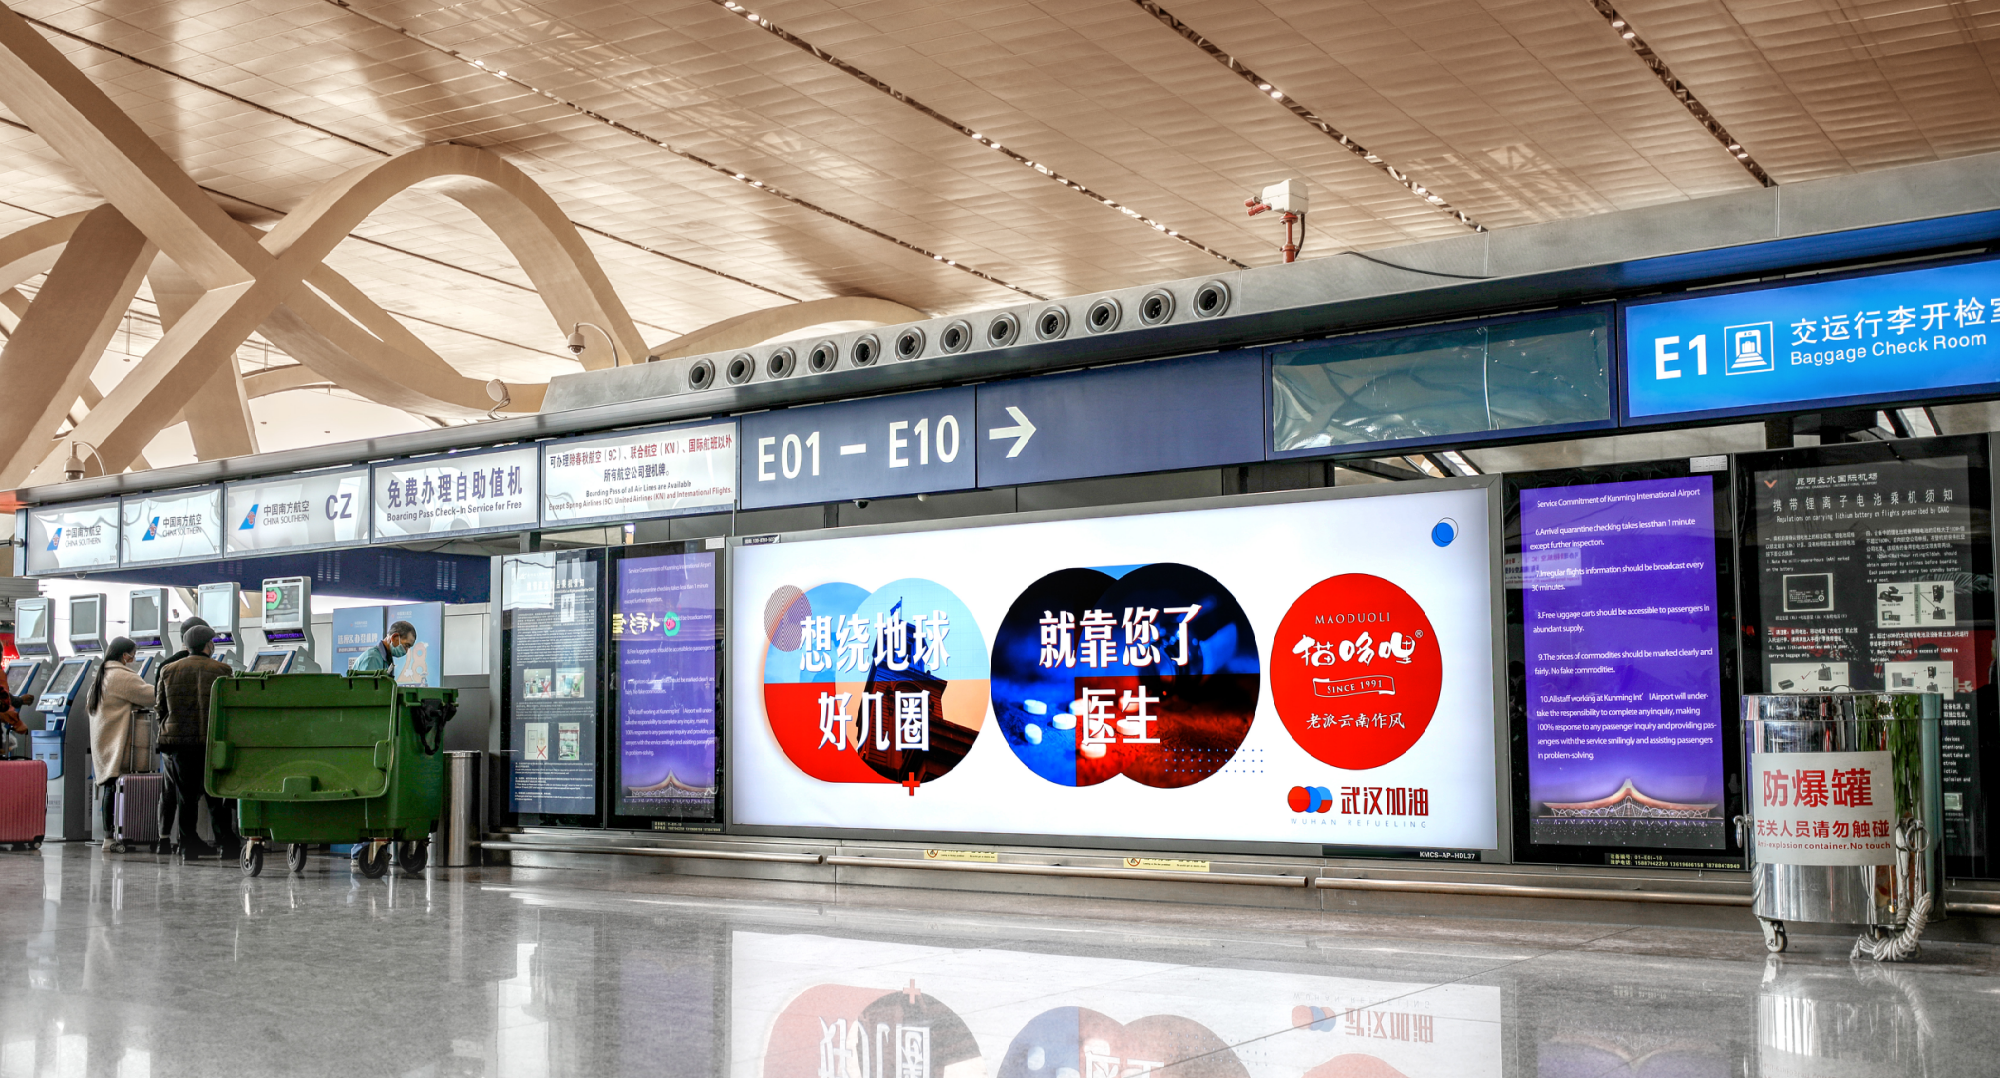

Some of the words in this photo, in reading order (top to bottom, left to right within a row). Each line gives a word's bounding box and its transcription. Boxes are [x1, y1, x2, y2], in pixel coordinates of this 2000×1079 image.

[1655, 334, 1707, 380] E1
[1790, 346, 1866, 366] Baggage
[1872, 339, 1928, 356] Check
[1933, 332, 1986, 349] Room
[758, 431, 820, 482] E01
[889, 414, 959, 468] E10
[387, 465, 522, 508] 免费办理自助值机
[1558, 496, 1599, 506] Commitment
[1607, 494, 1635, 503] Kunming
[1637, 489, 1676, 500] International
[1678, 488, 1700, 497] Airport
[1773, 488, 1952, 512] 携带锂离子电池乘机须知
[263, 500, 310, 516] 中国南方航空
[325, 493, 352, 520] CZ
[387, 511, 417, 521] Boarding
[419, 510, 433, 518] Pass
[468, 503, 493, 513] Service
[495, 501, 504, 510] for
[507, 500, 521, 509] Free
[163, 513, 202, 528] 中国南方航空
[263, 517, 279, 526] CHINA
[1560, 525, 1593, 535] quarantine
[1594, 523, 1621, 532] checking
[1622, 521, 1638, 529] takes
[1672, 518, 1695, 526] minute
[66, 525, 101, 538] 中国南方航空
[1530, 543, 1549, 551] except
[1551, 540, 1571, 548] further
[1572, 538, 1604, 549] inspection.
[1566, 567, 1584, 577] flights
[1586, 565, 1621, 575] information
[1622, 563, 1643, 572] should
[1645, 563, 1652, 571] be
[1653, 561, 1685, 571] broadcast
[1686, 562, 1704, 570] every
[1540, 583, 1566, 591] minutes.
[1315, 612, 1390, 624] MAODUOLI
[1582, 610, 1595, 618] carts
[1618, 608, 1626, 616] be
[1628, 606, 1658, 616] accessible
[1668, 605, 1703, 615] passengers
[1039, 604, 1202, 668] 就靠您了
[1533, 625, 1562, 633] abundant
[1563, 625, 1584, 633] supply.
[799, 609, 950, 673] 想绕地球
[1538, 653, 1555, 661] 9.The
[1581, 650, 1621, 660] commodities
[1622, 650, 1643, 658] should
[1653, 648, 1677, 657] marked
[1679, 648, 1699, 657] clearly
[1535, 667, 1550, 676] fairly.
[1560, 666, 1573, 674] fake
[1327, 683, 1355, 694] SINCE
[1360, 679, 1383, 689] 1991
[1571, 693, 1595, 703] working
[1604, 693, 1632, 703] Kunming
[1652, 693, 1674, 702] Airport
[1674, 692, 1686, 700] will
[1687, 692, 1708, 700] under-
[1082, 685, 1160, 746] 医生
[1536, 709, 1549, 717] take
[1550, 709, 1560, 717] the
[1561, 708, 1600, 717] responsibility
[1601, 708, 1608, 716] to
[1609, 707, 1637, 717] complete
[1639, 709, 1650, 717] any
[1650, 707, 1675, 717] inquiry,
[1676, 706, 1700, 716] making
[817, 689, 930, 751] 好几圈
[1306, 712, 1405, 730] 老派云南作风
[1763, 768, 1873, 808] 防爆罐
[1341, 787, 1428, 816] 武汉加油
[1348, 820, 1426, 828] REFUELING
[1757, 820, 1890, 838] 无关人员请勿触碰
[1865, 841, 1891, 850] touch
[1420, 851, 1475, 859] KMCS-AP-HDL37
